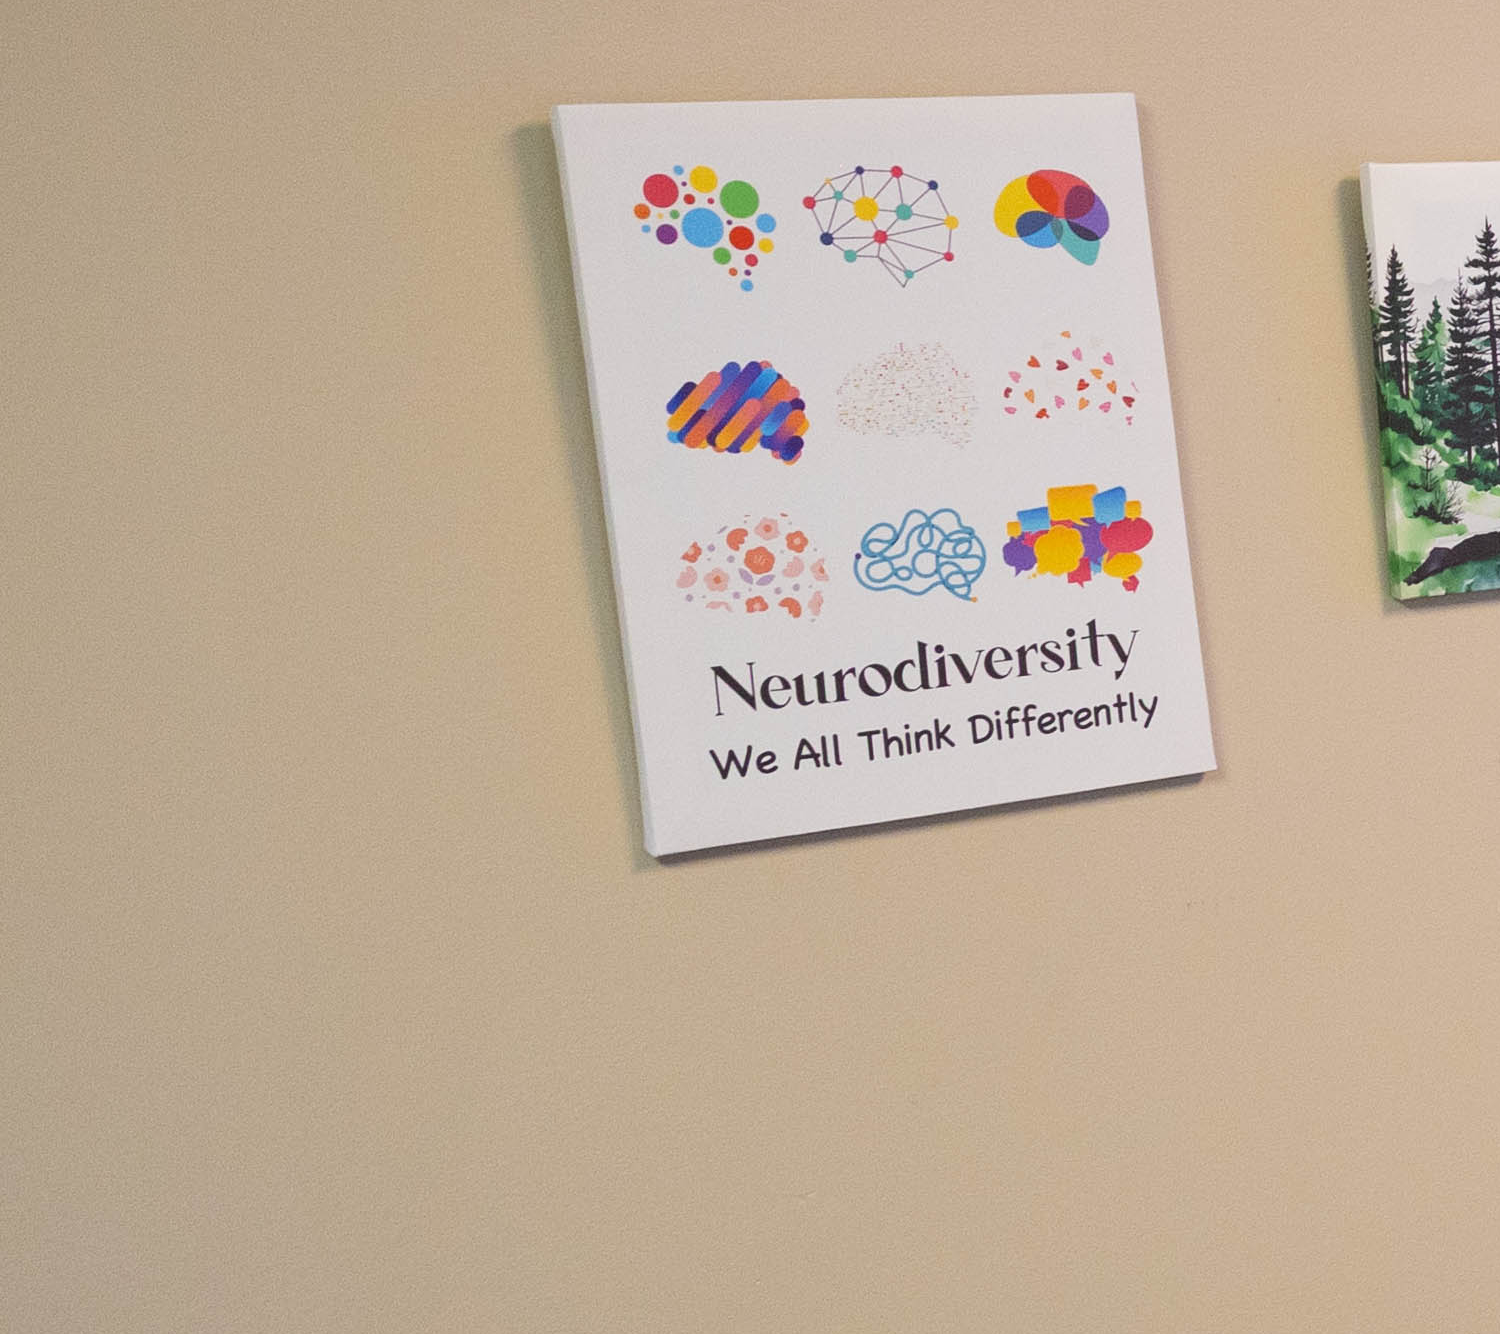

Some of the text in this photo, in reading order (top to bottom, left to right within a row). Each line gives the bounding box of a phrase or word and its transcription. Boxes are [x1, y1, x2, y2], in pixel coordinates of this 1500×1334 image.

[711, 619, 1140, 715] Neurodiversity
[710, 692, 1158, 779] We All Think Differently
